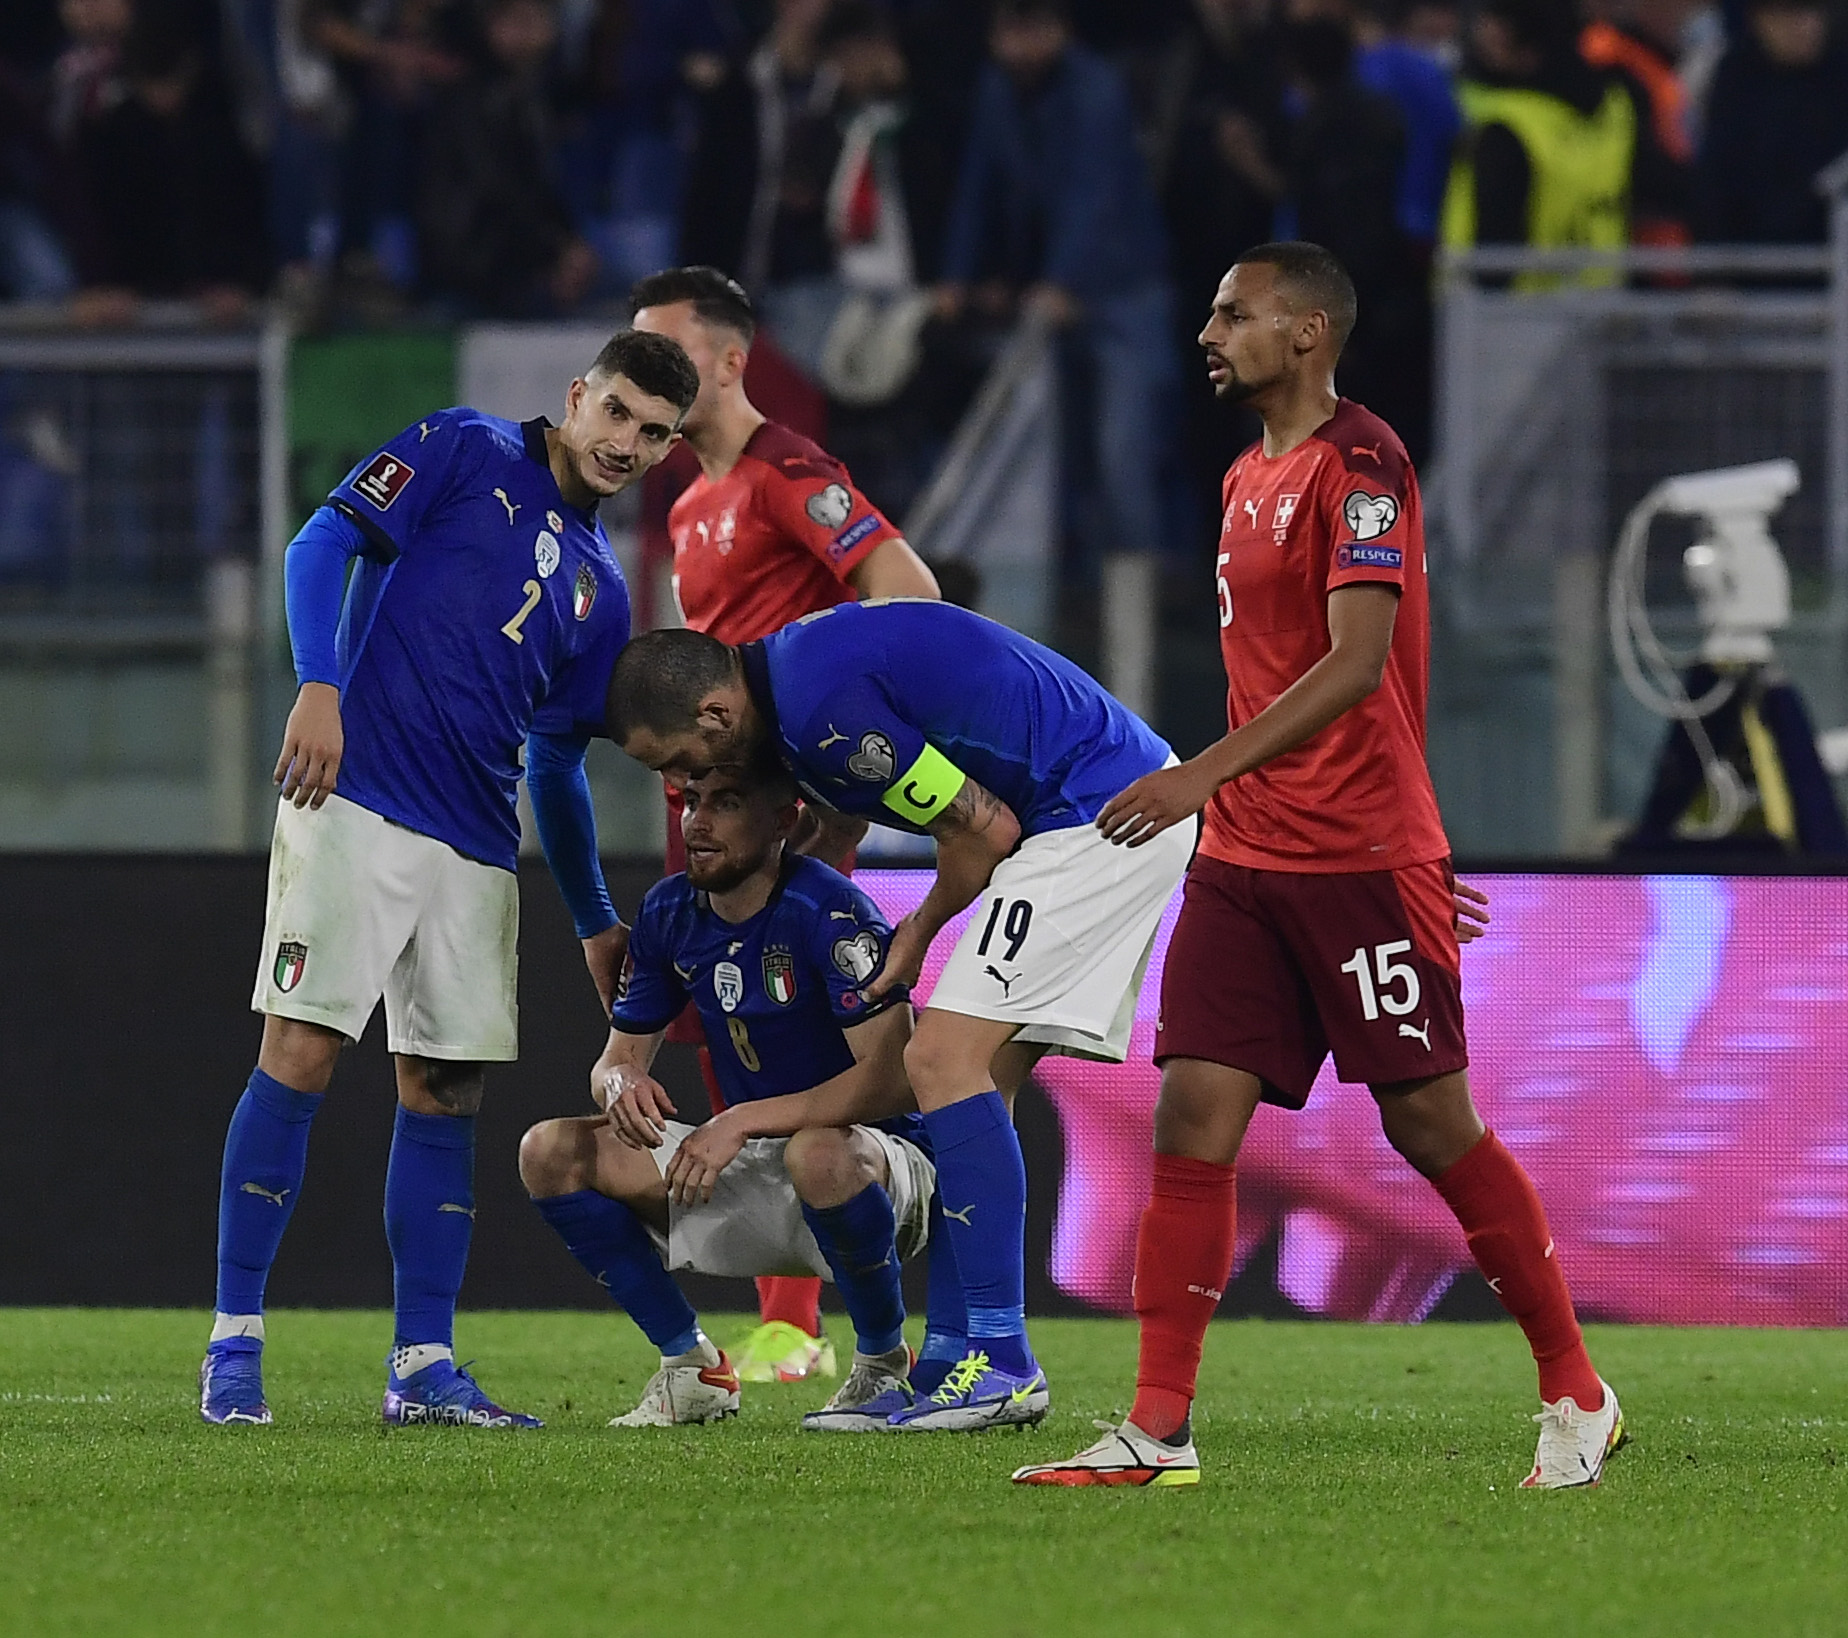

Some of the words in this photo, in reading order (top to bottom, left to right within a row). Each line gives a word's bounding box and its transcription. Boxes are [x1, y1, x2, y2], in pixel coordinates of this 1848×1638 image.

[1353, 549, 1401, 563] RESPECT
[501, 579, 541, 645] 2
[903, 780, 938, 809] C
[976, 896, 1033, 962] 19
[1341, 939, 1421, 1021] 15
[726, 1016, 761, 1073] 8
